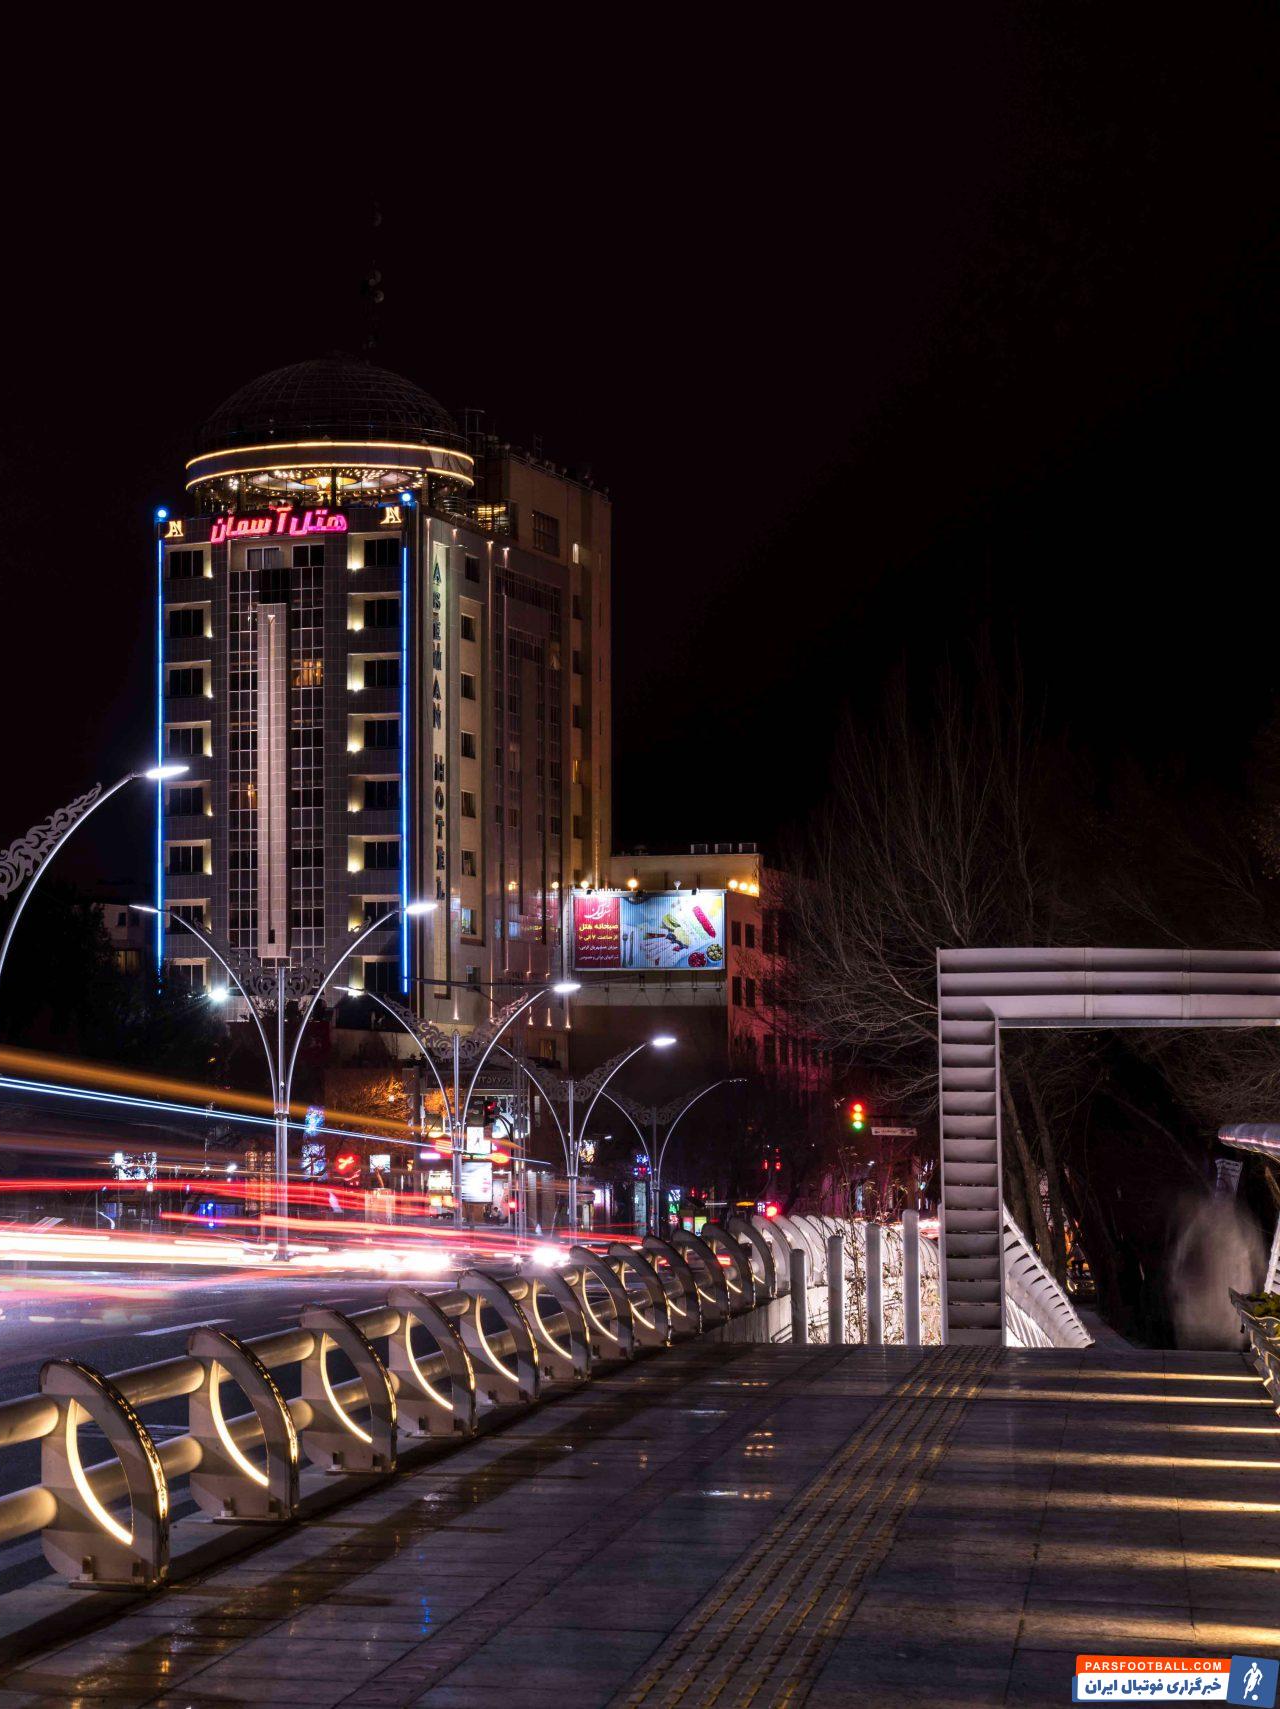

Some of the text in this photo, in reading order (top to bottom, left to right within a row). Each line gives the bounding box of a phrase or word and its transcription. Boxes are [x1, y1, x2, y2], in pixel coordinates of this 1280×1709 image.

[210, 503, 349, 544] هتل آسمان
[432, 558, 445, 900] ASEMAN HOTEL
[579, 923, 593, 932] هتل
